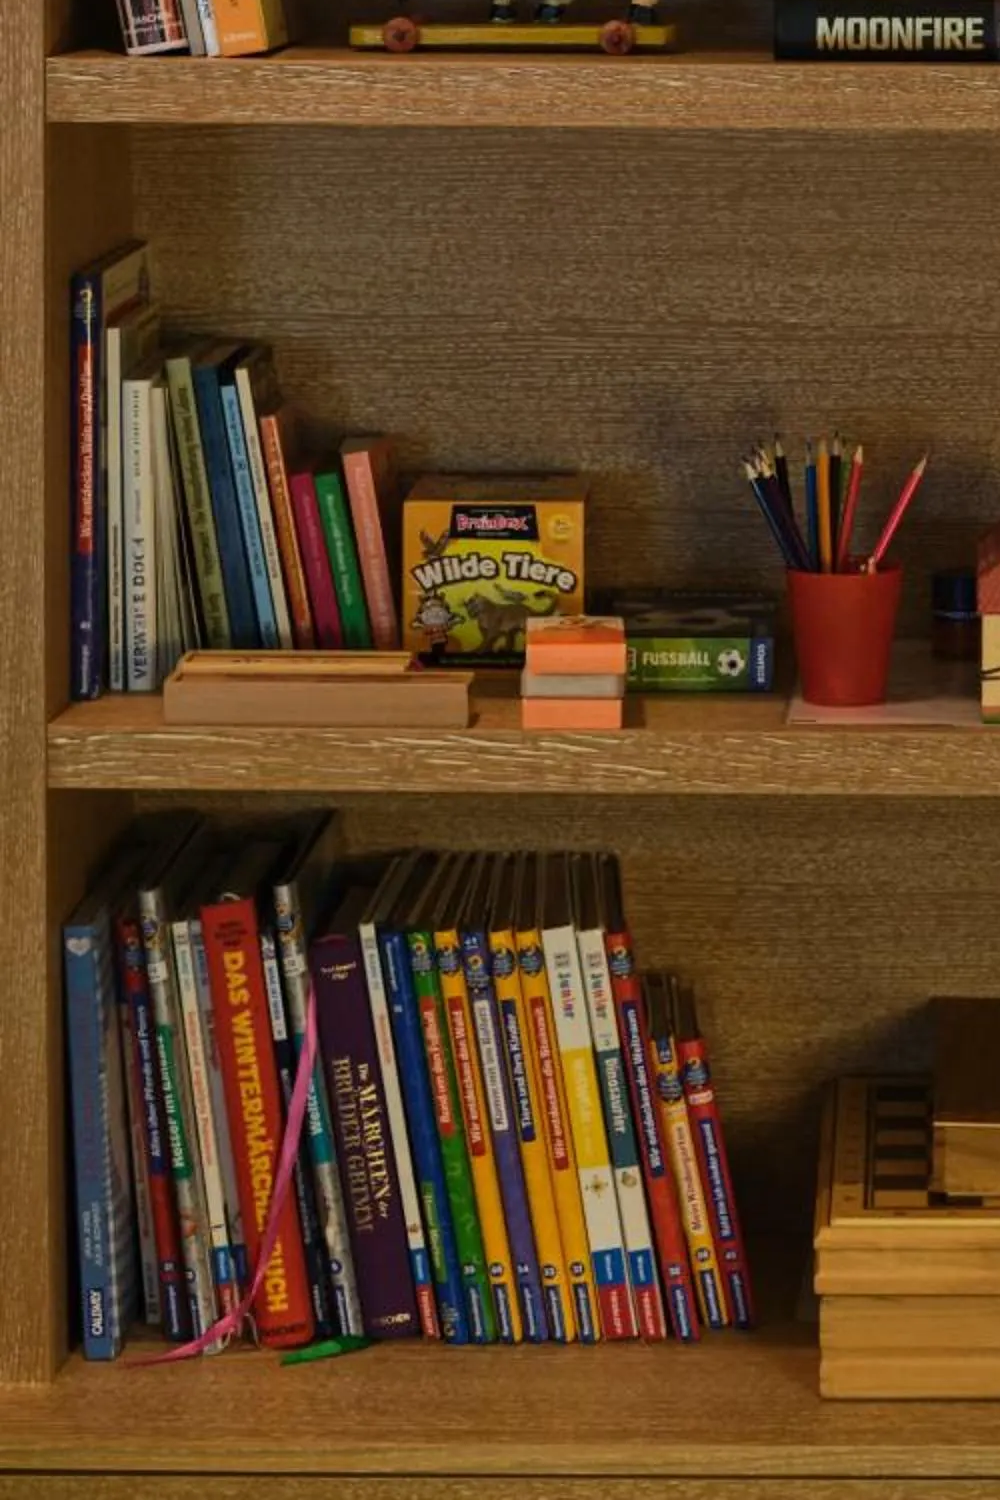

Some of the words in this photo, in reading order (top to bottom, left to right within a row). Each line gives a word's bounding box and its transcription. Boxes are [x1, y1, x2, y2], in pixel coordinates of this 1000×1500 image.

[815, 16, 985, 51] MOONFIRE
[413, 553, 498, 590] Wilde
[503, 553, 576, 592] Tiere
[642, 651, 712, 666] FUSSBALL
[222, 949, 250, 1006] DAS
[558, 972, 576, 1019] Junior
[592, 971, 608, 1020] Junior
[329, 1056, 365, 1149] BRÜDER
[604, 1057, 627, 1135] Dinosaurier
[229, 1009, 294, 1313] WINTERMÄRCHUCH
[356, 1082, 393, 1200] MÄRCHEN
[343, 1153, 377, 1233] GRIMM
